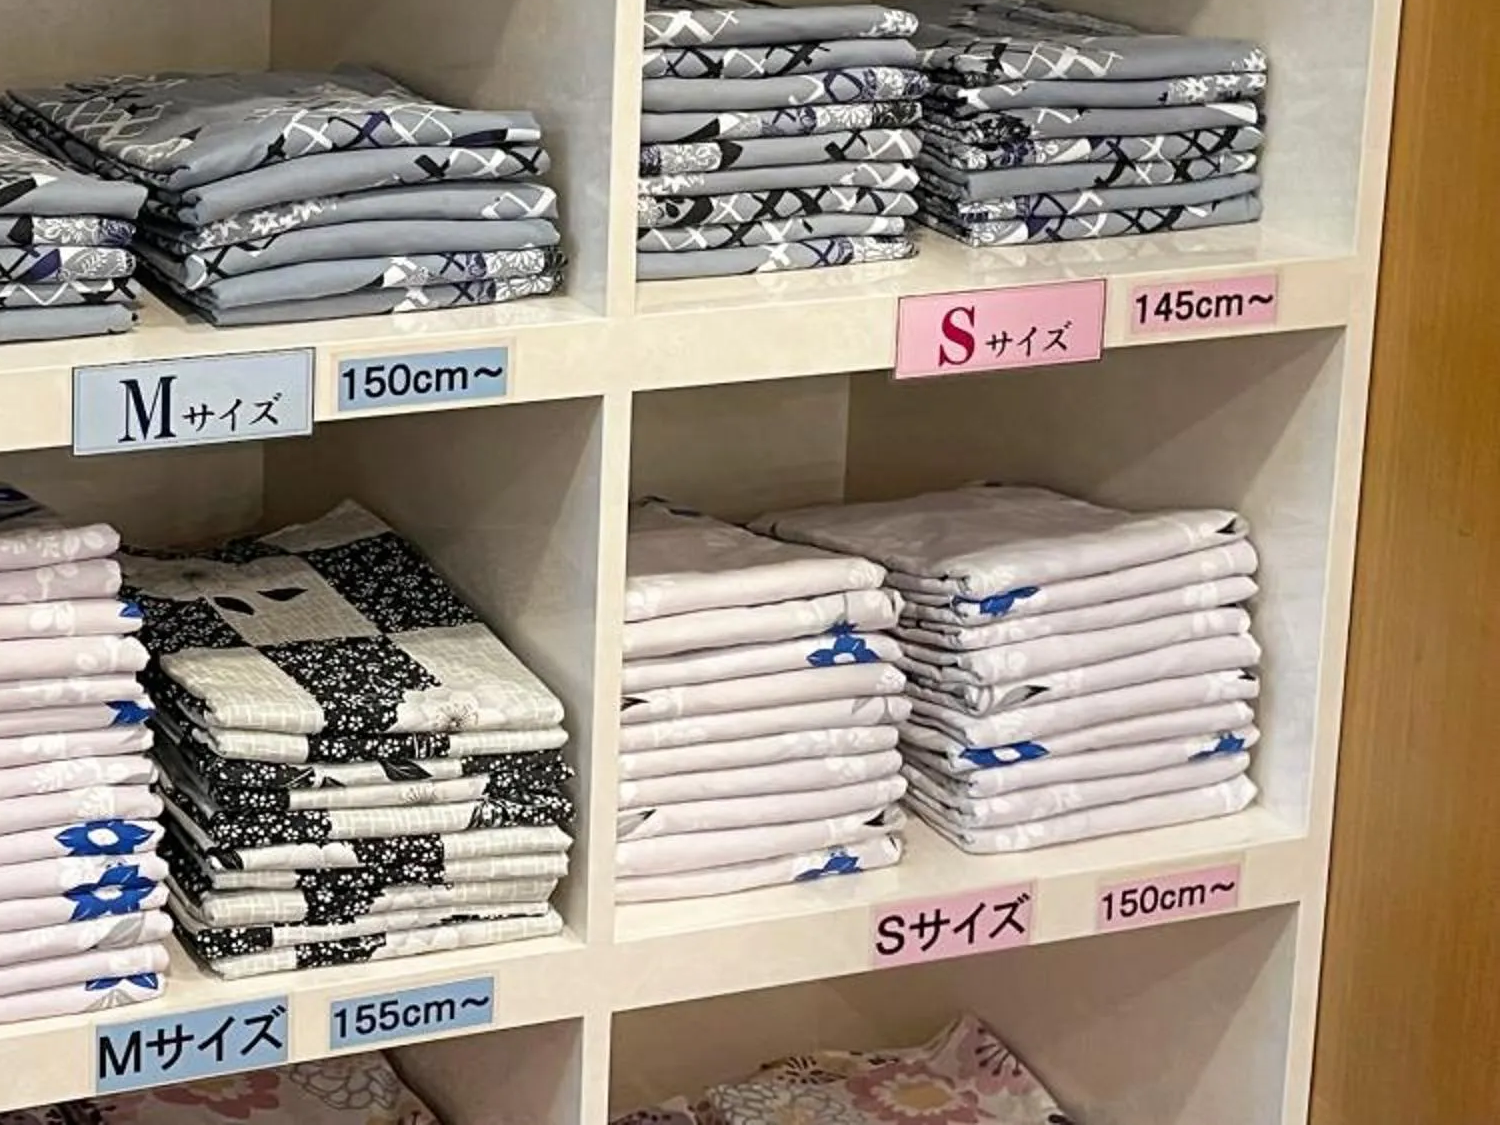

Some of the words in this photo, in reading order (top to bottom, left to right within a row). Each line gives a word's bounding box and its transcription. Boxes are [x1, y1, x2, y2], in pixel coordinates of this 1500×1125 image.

[938, 306, 1072, 367] Sサイズ
[118, 376, 282, 443] Mサイズ
[875, 892, 1031, 956] Sサイズ
[99, 1004, 286, 1079] Mサイズ
